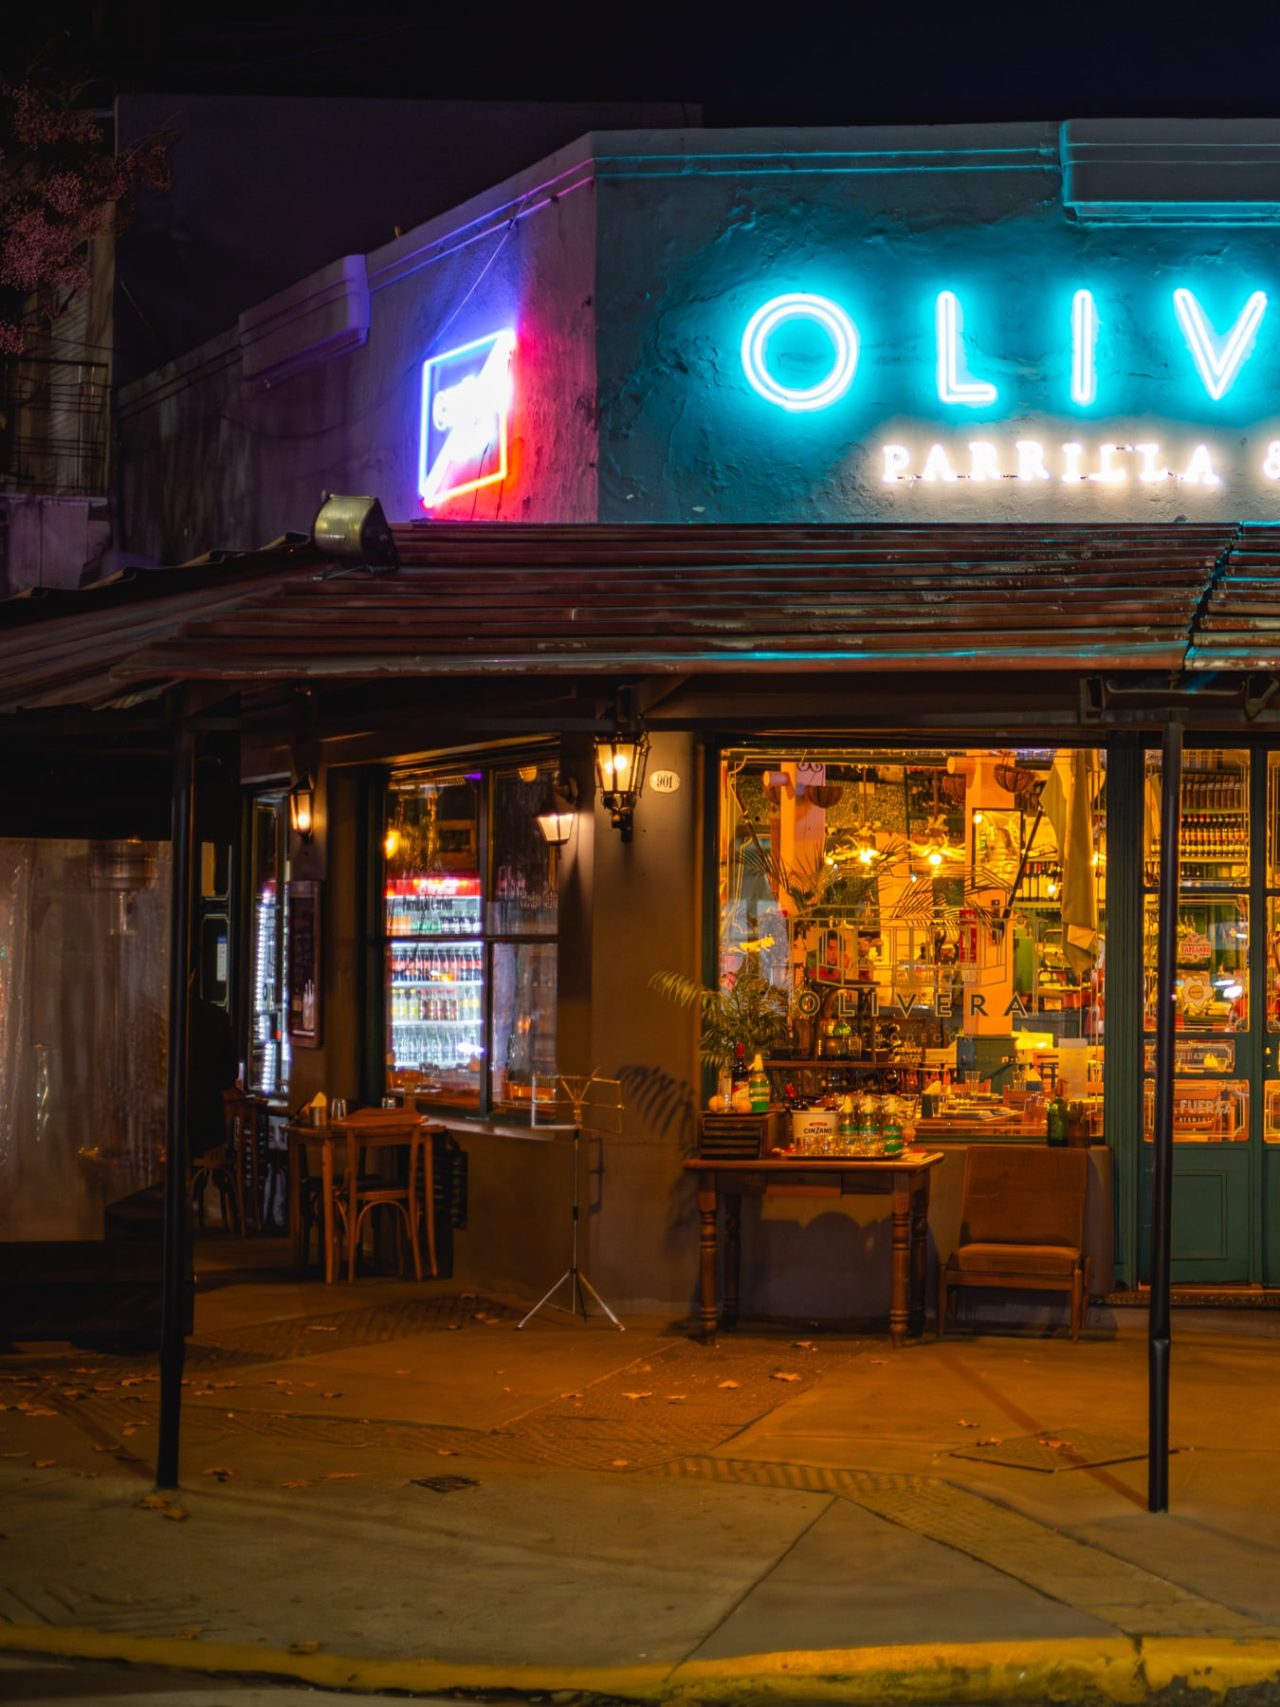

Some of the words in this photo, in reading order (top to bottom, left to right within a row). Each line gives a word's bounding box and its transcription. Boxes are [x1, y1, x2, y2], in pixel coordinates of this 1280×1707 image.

[881, 440, 1222, 486] PARRILLA
[798, 991, 1028, 1019] OLIVERA
[803, 1127, 833, 1135] CINZANO
